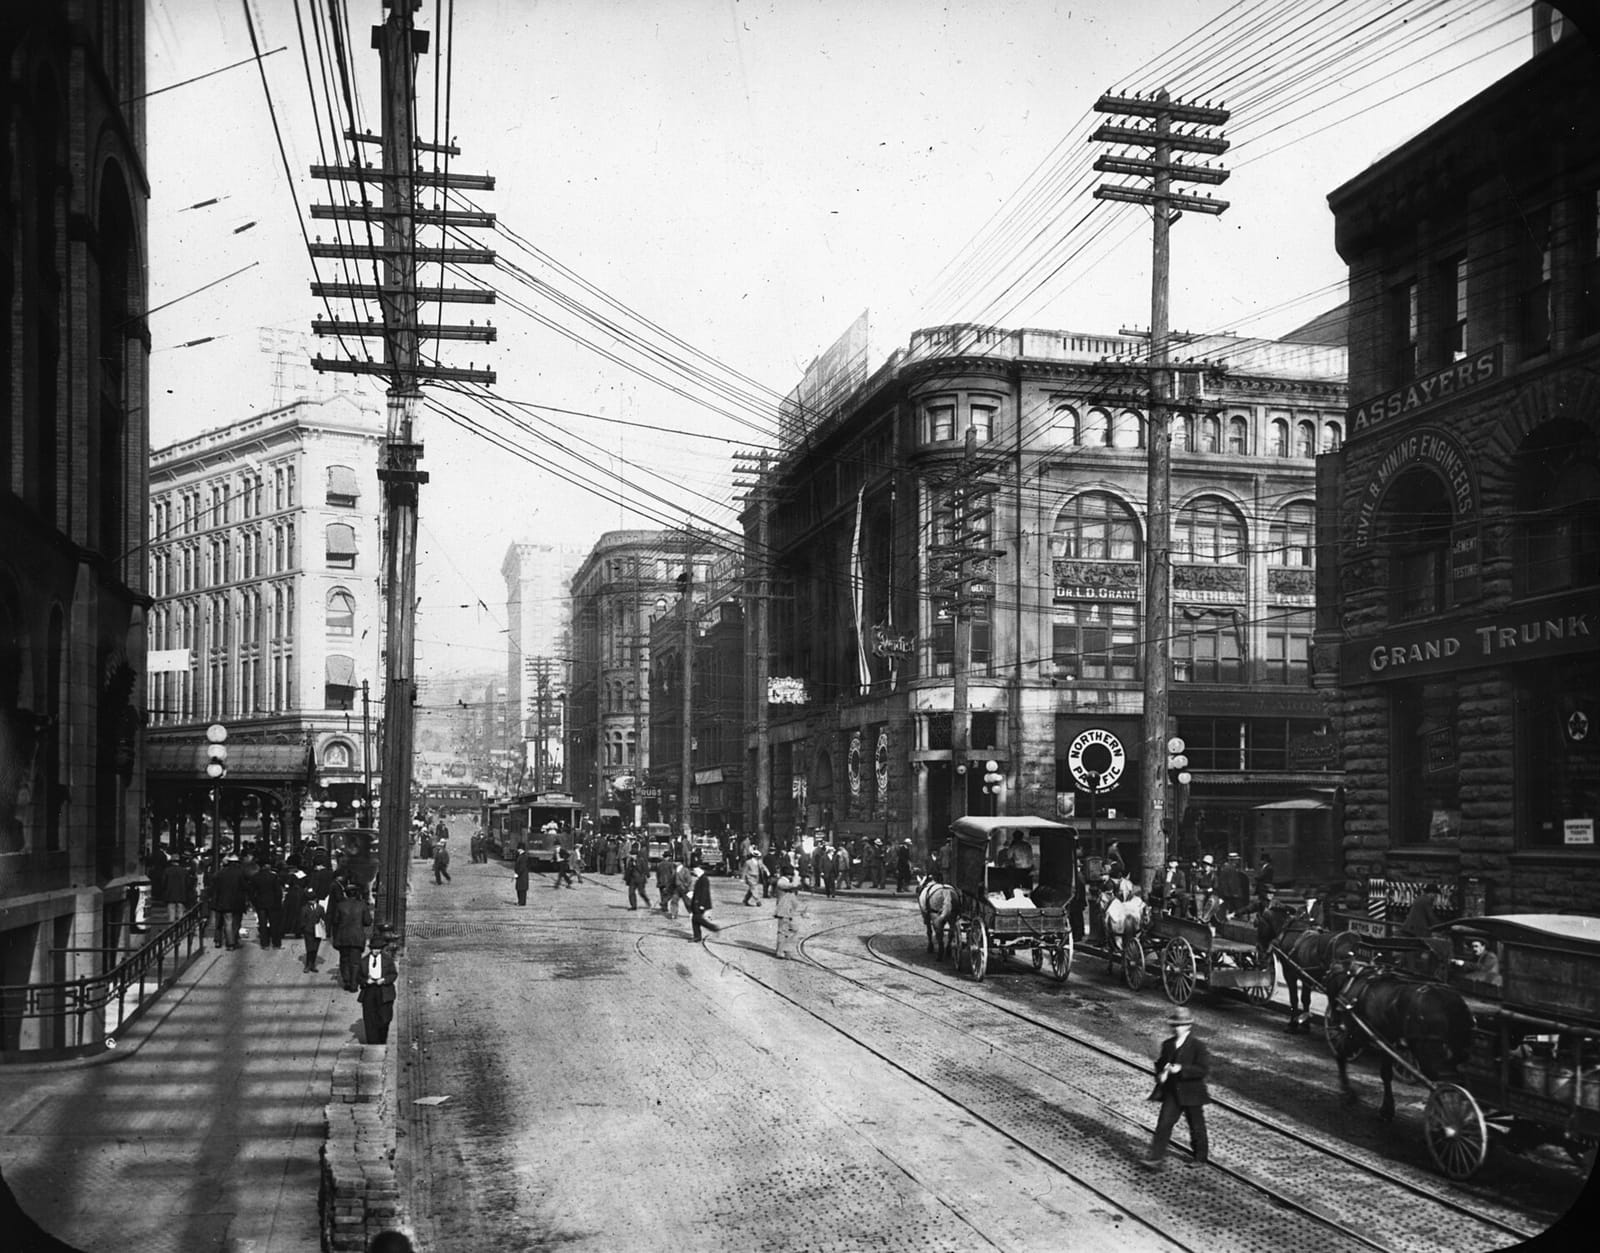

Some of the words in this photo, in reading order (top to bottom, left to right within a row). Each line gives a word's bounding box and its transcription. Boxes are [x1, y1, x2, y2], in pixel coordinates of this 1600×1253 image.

[1353, 353, 1494, 432] ASSAYERS
[1356, 501, 1374, 549] CIVIL
[1369, 485, 1380, 498] &
[1378, 437, 1417, 484] MINING
[1420, 435, 1473, 514] ENGINEERS
[1369, 638, 1461, 671] GRAND
[1476, 615, 1590, 655] TRUNK
[1070, 731, 1123, 758] NORTHERN
[1073, 766, 1120, 785] PAFIC
